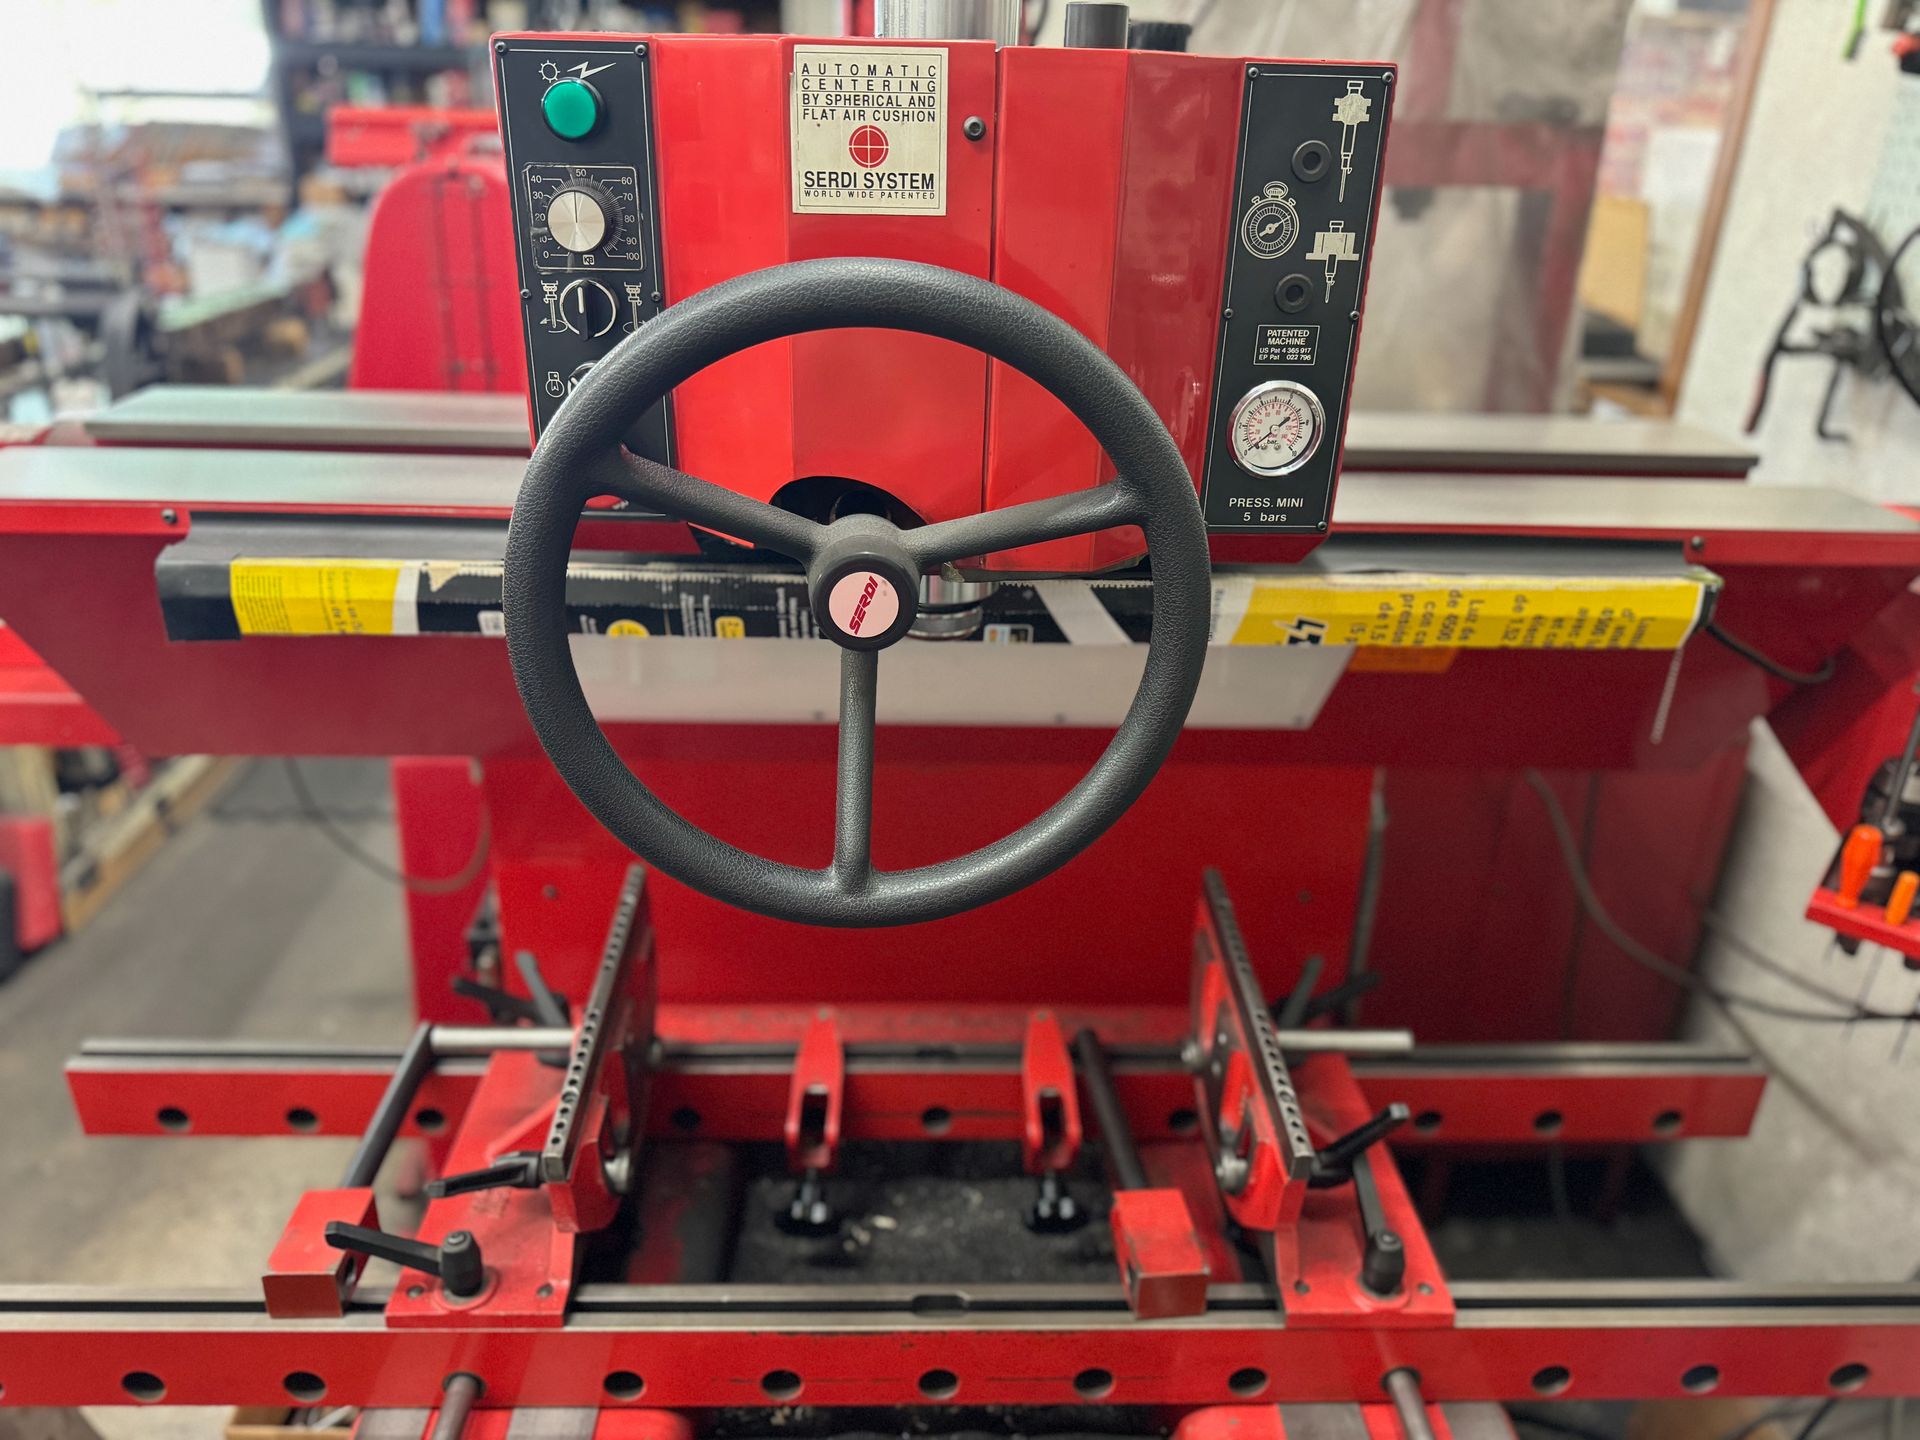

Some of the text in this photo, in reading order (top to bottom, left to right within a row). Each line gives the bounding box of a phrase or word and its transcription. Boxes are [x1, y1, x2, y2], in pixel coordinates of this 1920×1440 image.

[802, 63, 936, 77] AUTOMATIC
[802, 78, 936, 92] CENTERING
[802, 94, 936, 108] BY SPHERICAL AND
[803, 108, 936, 122] FLAT AIR CUSHION
[576, 168, 587, 177] 50
[530, 175, 542, 183] 40
[622, 176, 632, 184] 60
[804, 170, 934, 190] SERDI SYSTEM
[532, 191, 544, 199] 30
[622, 193, 633, 201] 70
[534, 213, 546, 222] 20
[624, 214, 635, 222] 80
[626, 252, 640, 261] 100
[1267, 329, 1310, 337] PATENTED
[1229, 498, 1304, 507] PRESS. MINI
[1243, 512, 1287, 522] 5 bars
[849, 576, 879, 635] SERDI
